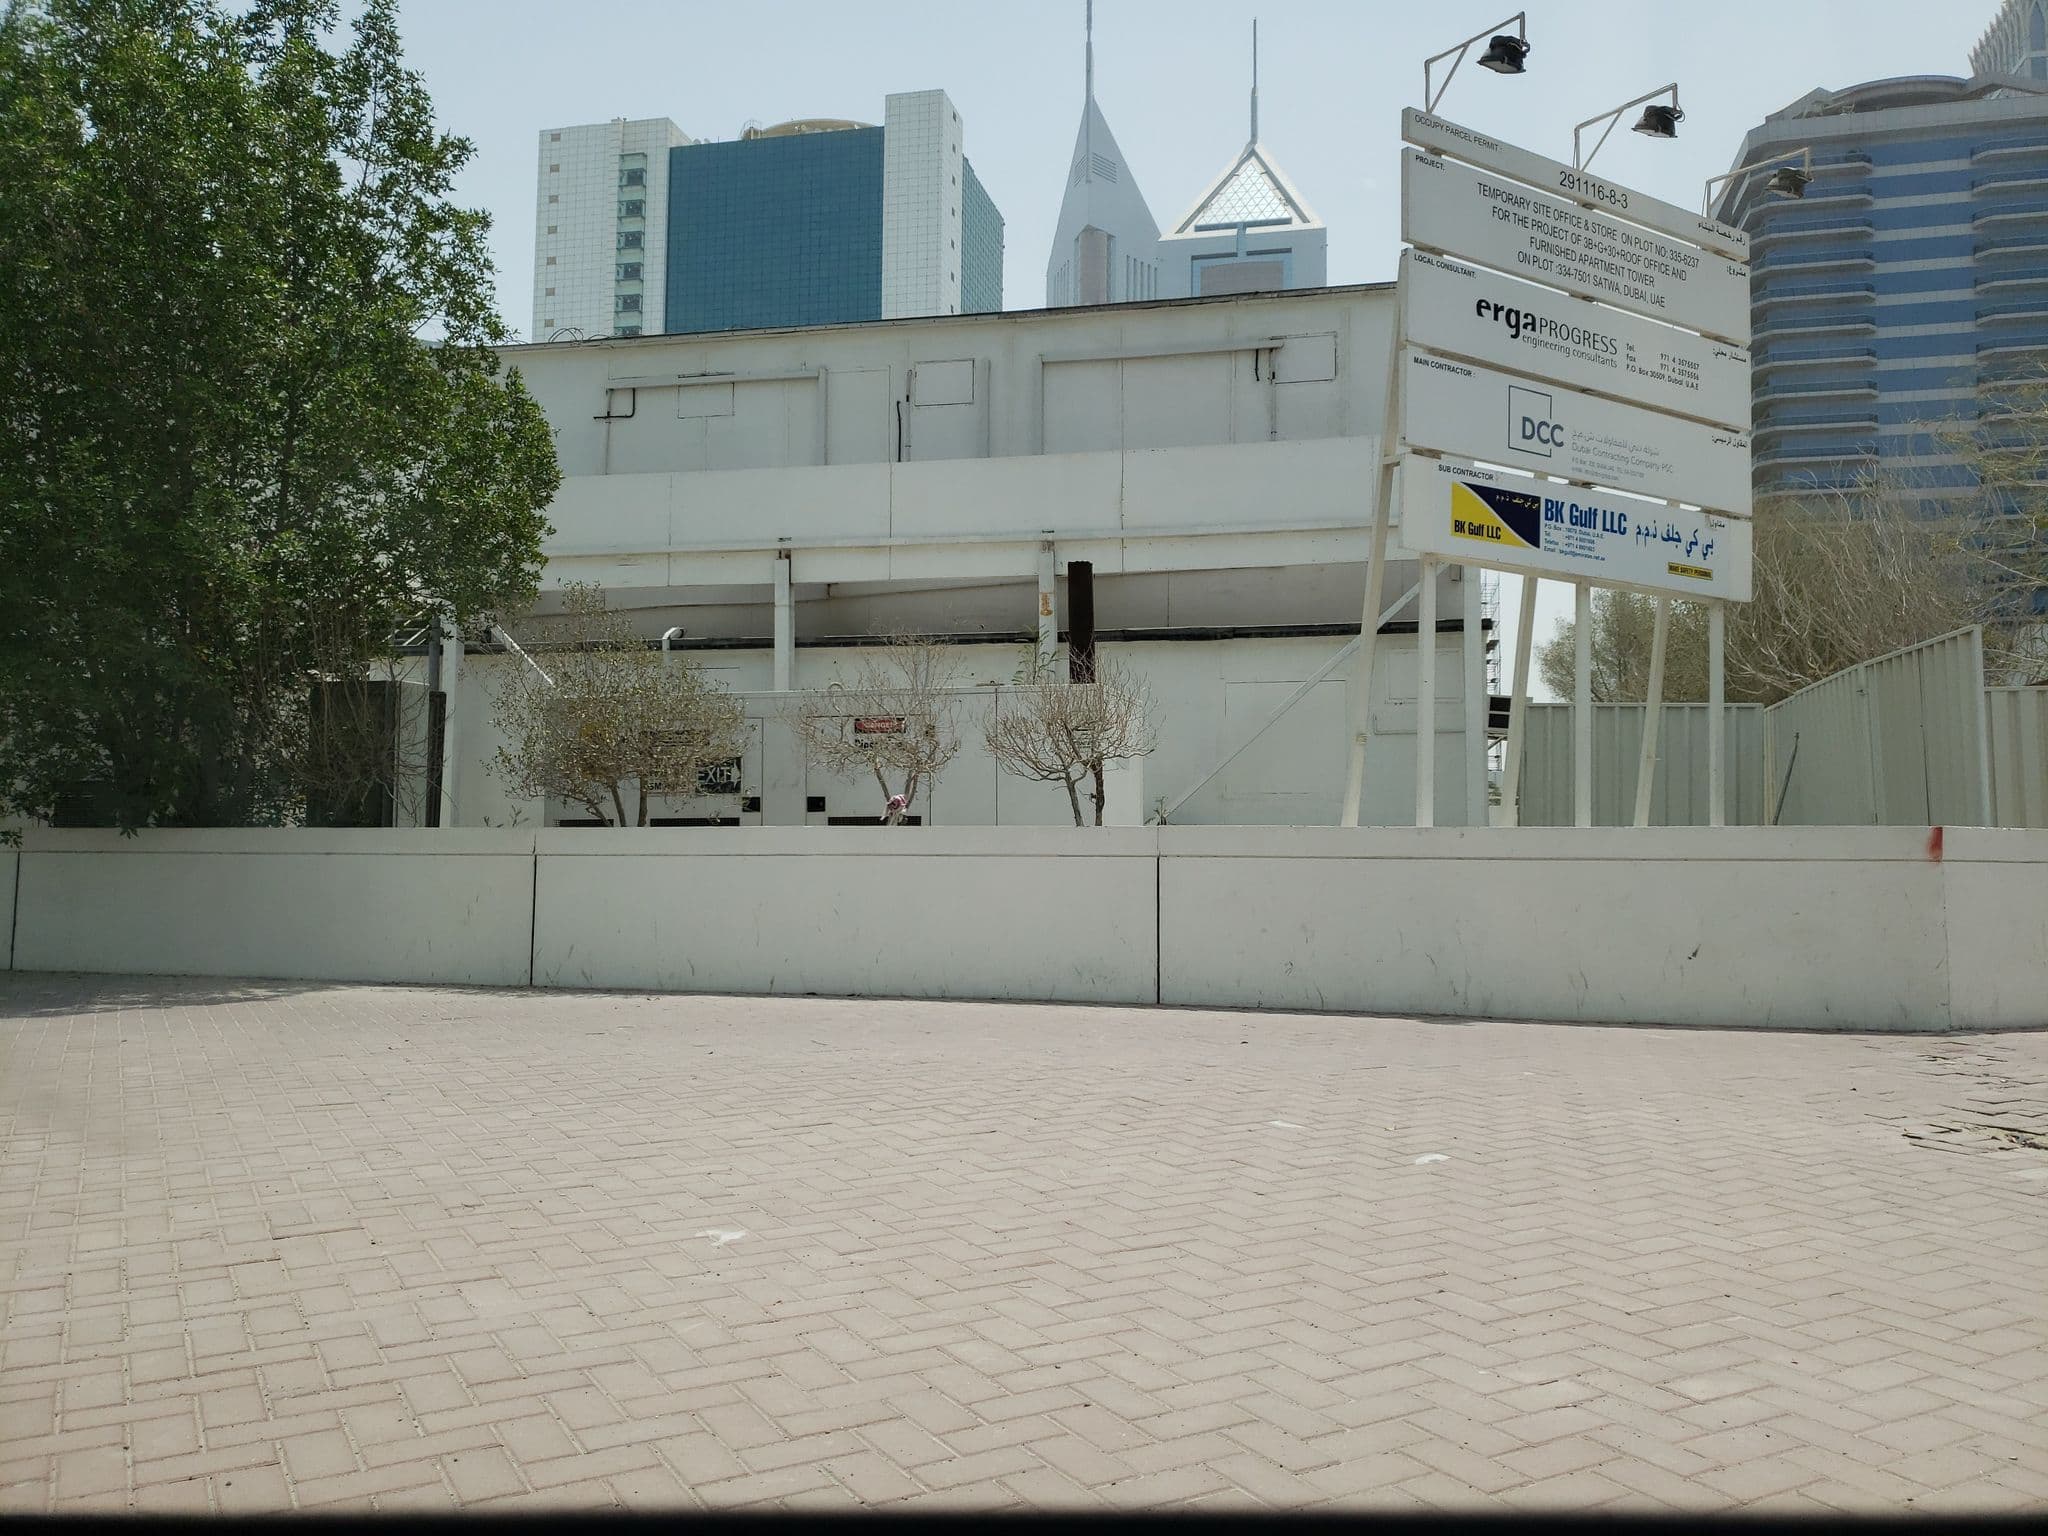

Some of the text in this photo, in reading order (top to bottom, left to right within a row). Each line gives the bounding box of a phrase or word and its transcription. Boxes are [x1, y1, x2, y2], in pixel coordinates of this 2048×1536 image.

[1414, 114, 1444, 131] OCCUPY
[1445, 125, 1473, 143] PARCEL
[1473, 136, 1499, 151] PERMIT
[1559, 170, 1628, 209] 291116-8-3
[1477, 182, 1531, 211] TEMPORARY
[1533, 201, 1551, 219] SITE
[1553, 209, 1582, 229] OFFICE
[1583, 219, 1590, 231] &
[1592, 222, 1618, 241] STORE
[1621, 232, 1633, 247] ON
[1634, 237, 1653, 253] PLOT
[1669, 249, 1700, 268] 335-6237
[1414, 253, 1435, 267] LOCAL
[1492, 206, 1687, 281] FOR THE PROJECT OF 3B+G+30+ROOF OFFICE AND
[1517, 250, 1531, 265] ON
[1532, 255, 1554, 272] PLOT
[1650, 292, 1666, 308] UAE
[1529, 236, 1655, 288] FURNISHED APARTMENT TOWER
[1476, 298, 1618, 356] erga PROGRESS
[1413, 355, 1430, 368] MAIN
[1430, 360, 1473, 378] CONTRACTOR
[1522, 333, 1618, 368] engineering consultants
[1521, 415, 1565, 448] DCC
[1438, 463, 1494, 481] SUB CONTRACTOR
[1454, 519, 1502, 540] BK Gulf LLC
[1544, 498, 1627, 536] BK Gulf LLC
[1660, 522, 1682, 549] جلف
[1685, 528, 1699, 558] كي
[1701, 537, 1714, 561] بي
